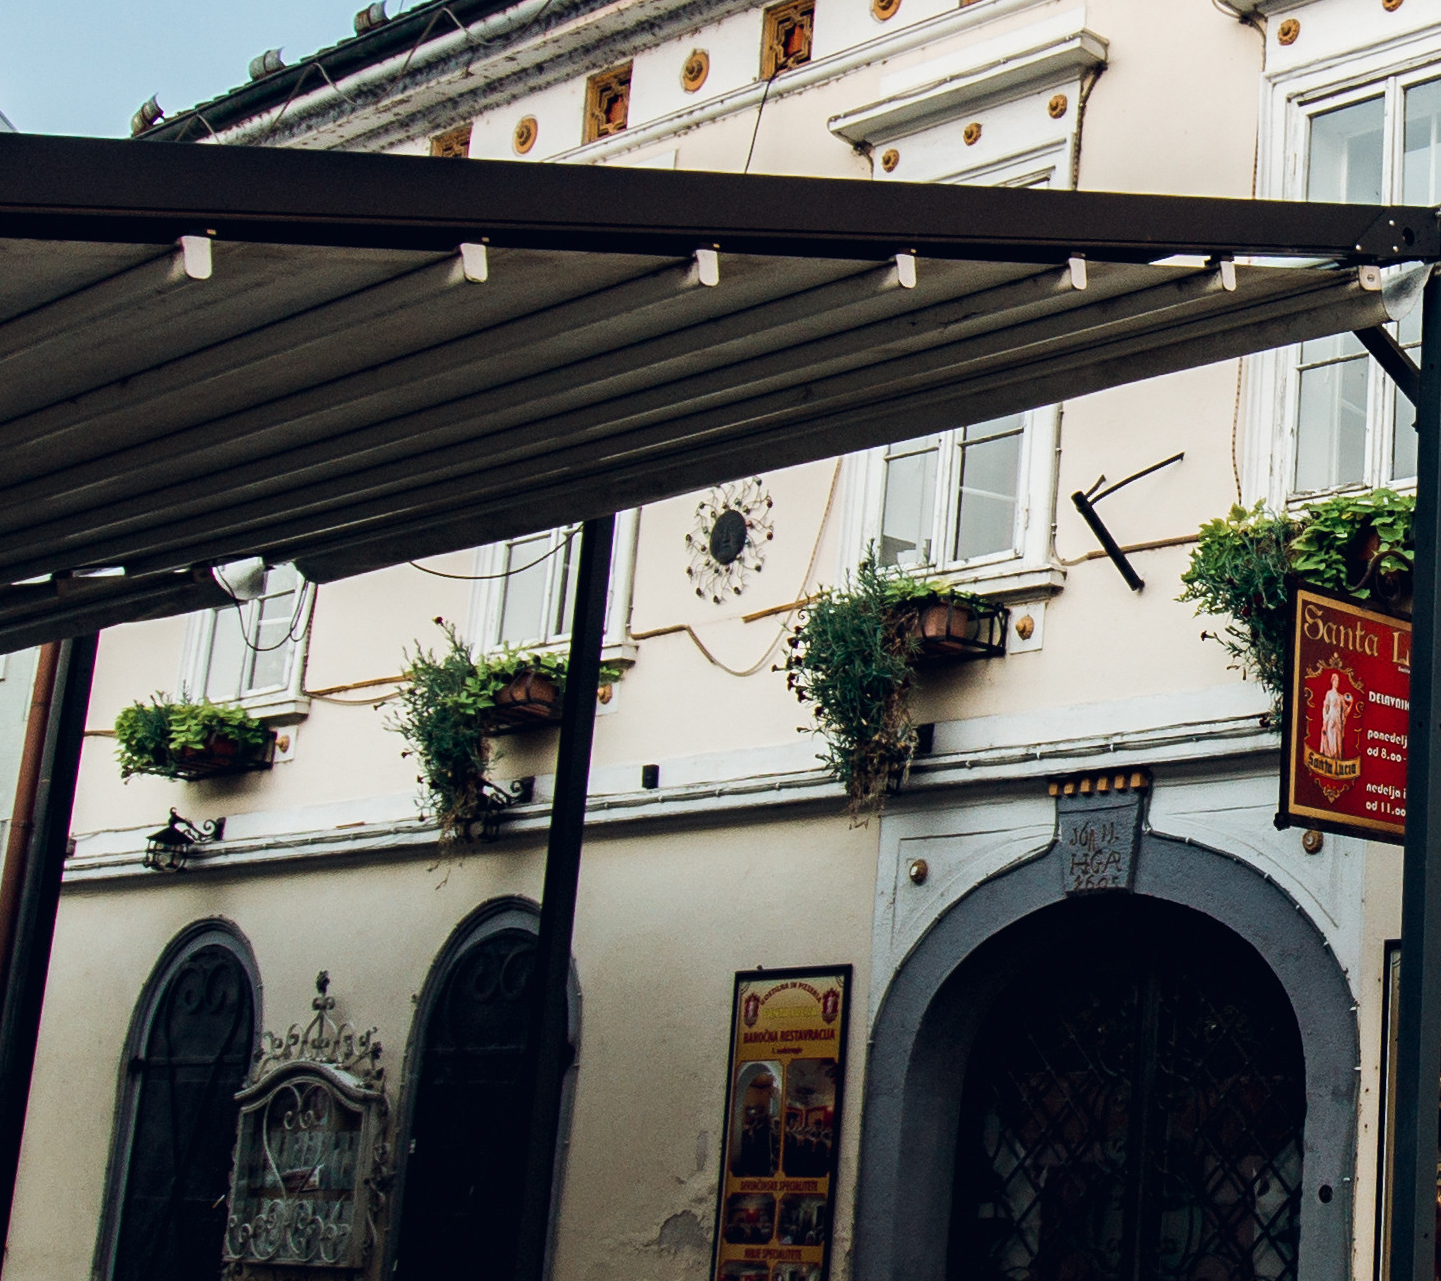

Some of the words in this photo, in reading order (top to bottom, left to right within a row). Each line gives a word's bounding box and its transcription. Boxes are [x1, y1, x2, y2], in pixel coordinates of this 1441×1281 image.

[1304, 604, 1378, 656] Santa
[1367, 729, 1408, 749] ponedelj
[1308, 752, 1333, 774] Santa
[1335, 760, 1357, 775] Lucia
[1367, 747, 1379, 757] od
[1381, 748, 1402, 762] 8.00
[1366, 783, 1401, 799] nedelja
[1366, 801, 1378, 811] od
[1381, 802, 1407, 817] 11.00
